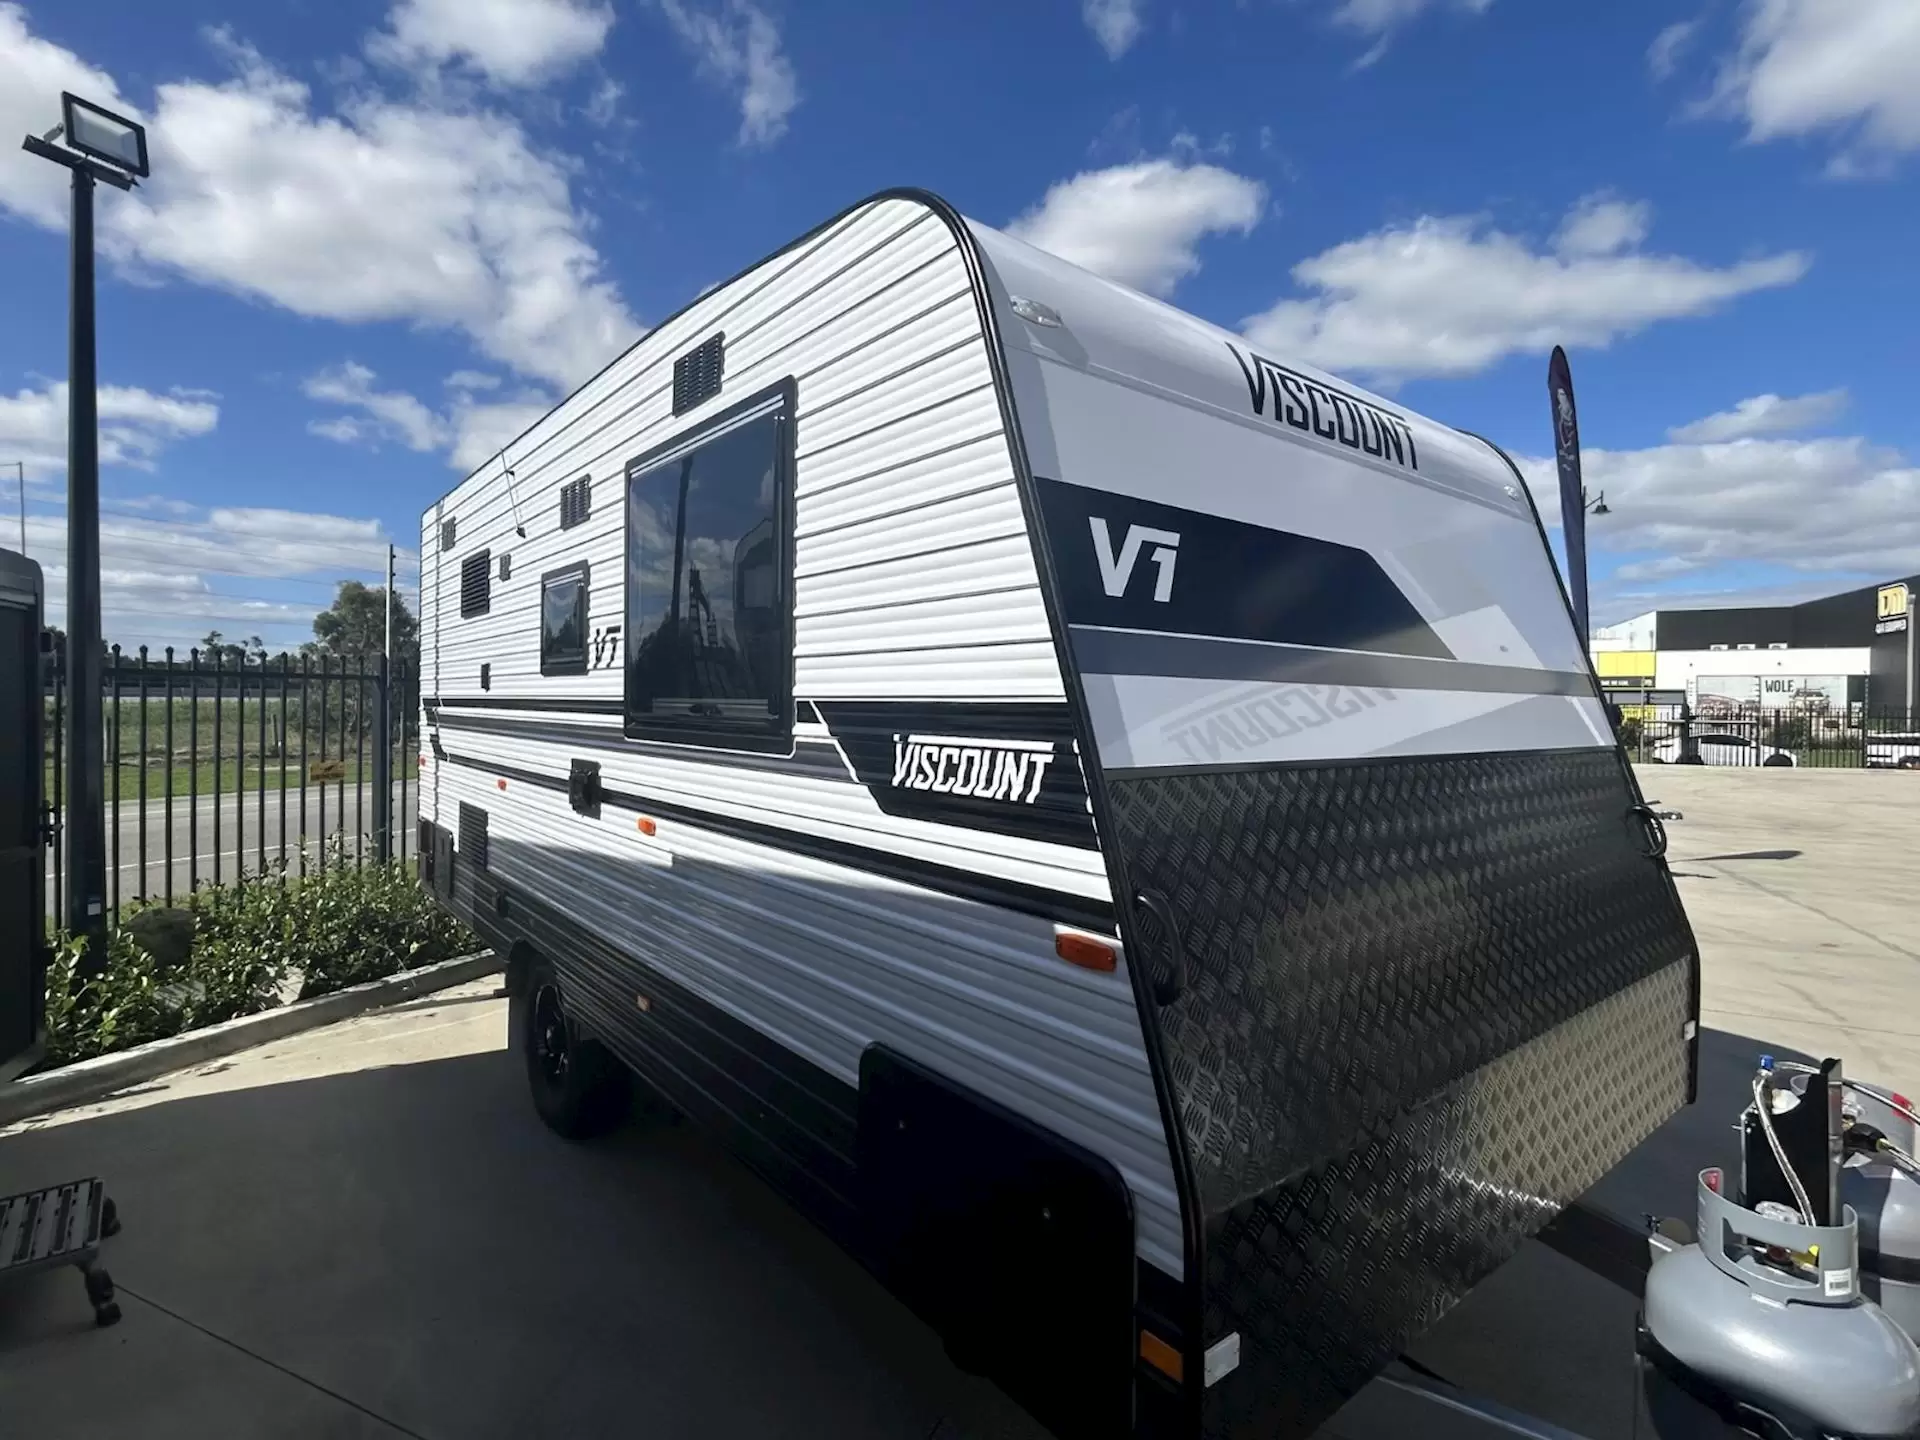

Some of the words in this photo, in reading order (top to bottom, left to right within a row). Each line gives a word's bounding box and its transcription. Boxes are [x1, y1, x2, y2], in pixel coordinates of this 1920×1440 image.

[1225, 341, 1418, 471] VISCOUNT
[1088, 516, 1180, 603] V1
[1765, 679, 1794, 693] WOLF
[892, 733, 1055, 804] VISCOUNT
